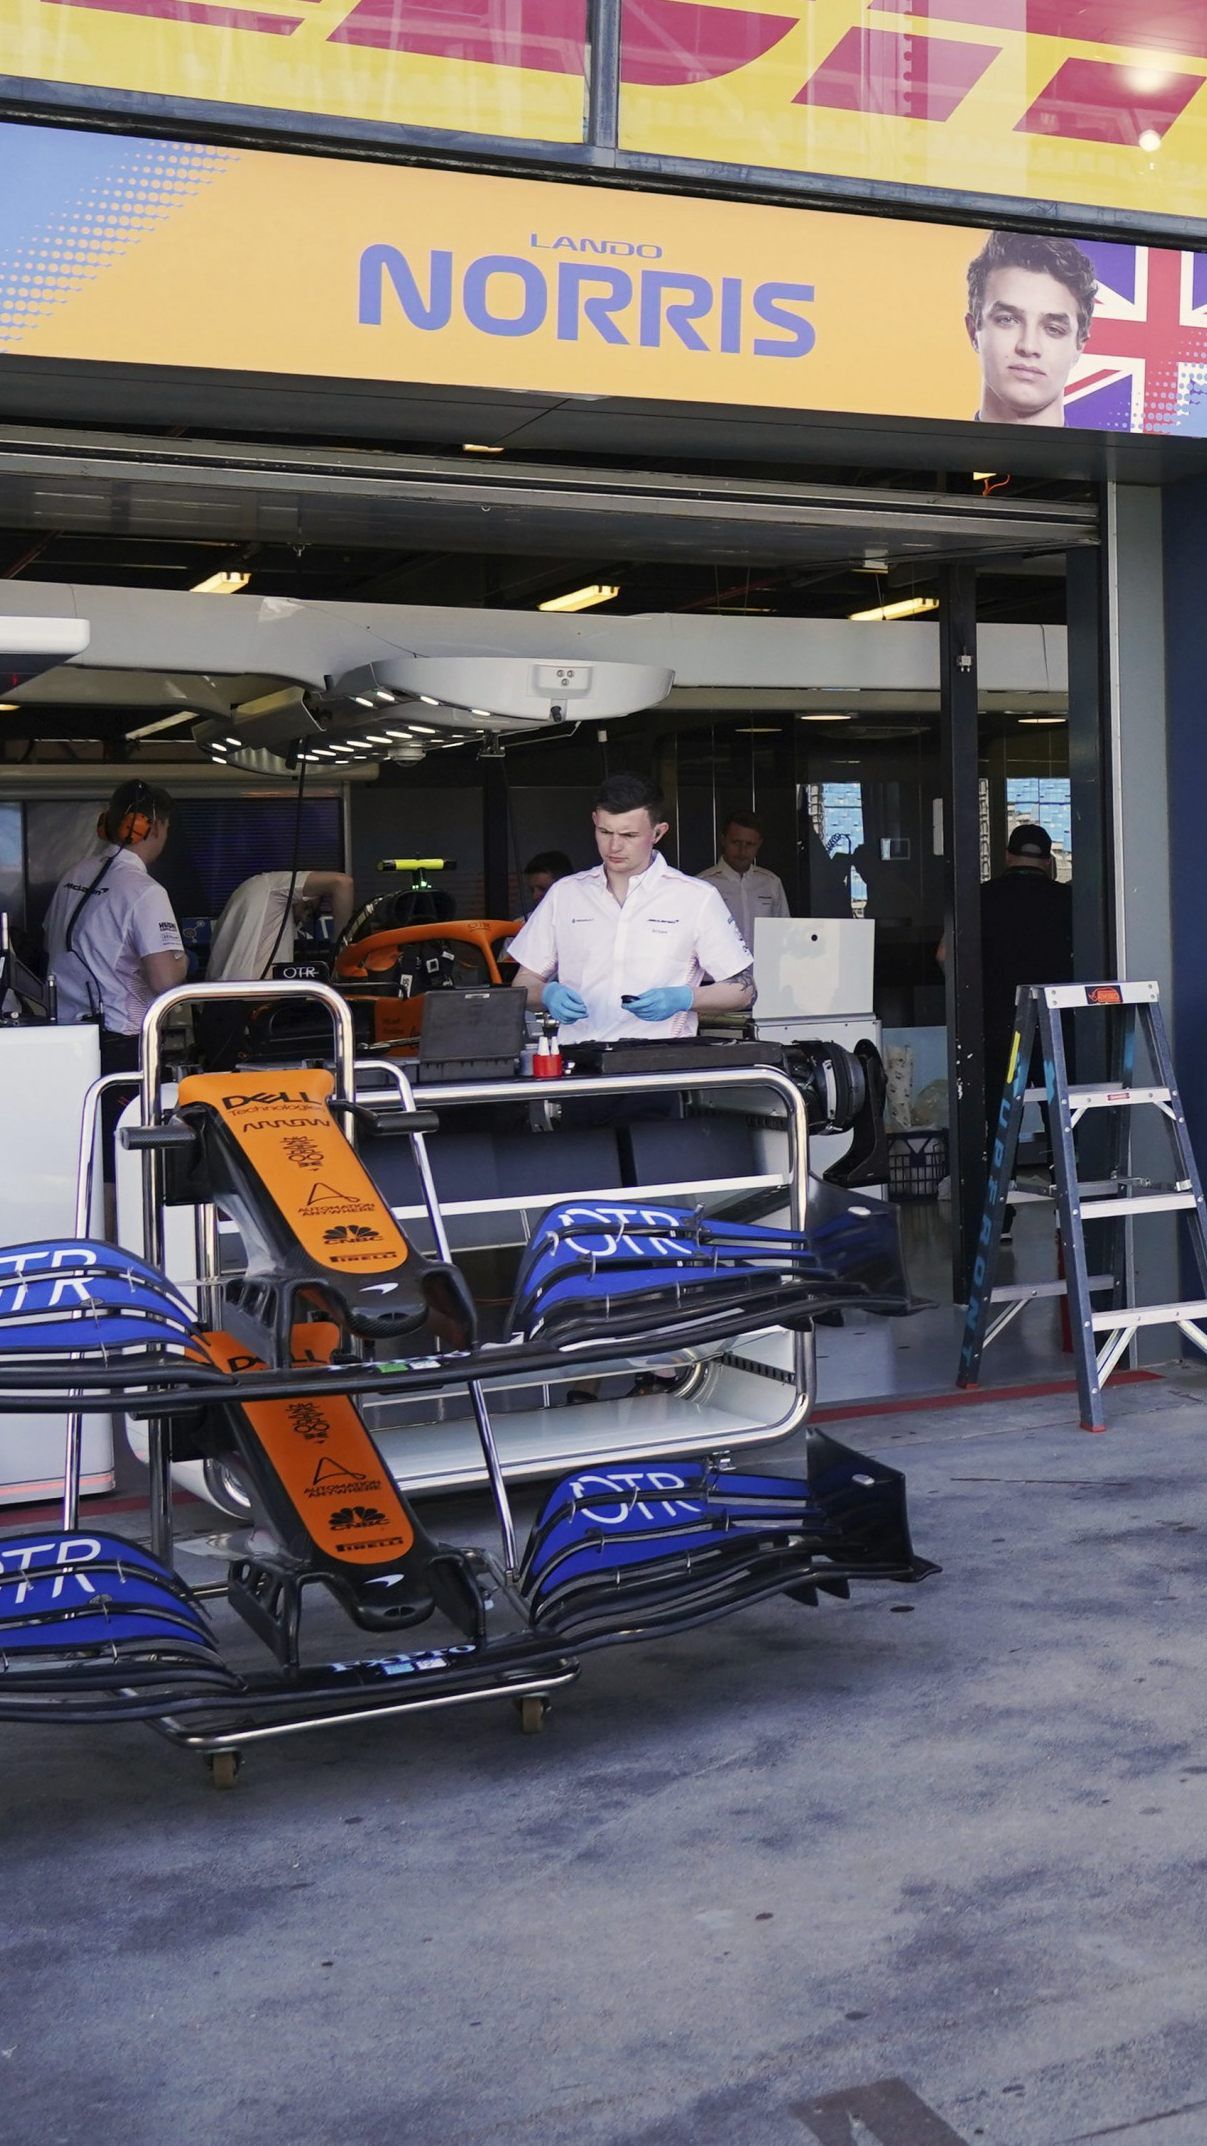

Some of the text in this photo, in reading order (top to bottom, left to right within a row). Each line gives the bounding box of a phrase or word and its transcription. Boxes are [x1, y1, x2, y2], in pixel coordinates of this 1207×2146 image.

[531, 233, 663, 259] LANDO
[358, 243, 816, 358] NORRIS
[283, 966, 319, 979] OTR
[222, 1092, 322, 1110] DELL
[298, 1203, 375, 1213] AUTOMATION
[324, 1235, 384, 1245] CNBC
[329, 1251, 397, 1263] PIRELLI
[0, 1249, 97, 1311] TR
[304, 1480, 381, 1494] AUTOMATION
[569, 1472, 702, 1524] OTR
[330, 1518, 391, 1531] CNBC
[336, 1536, 404, 1552] PIRELLI
[0, 1538, 101, 1604] TR
